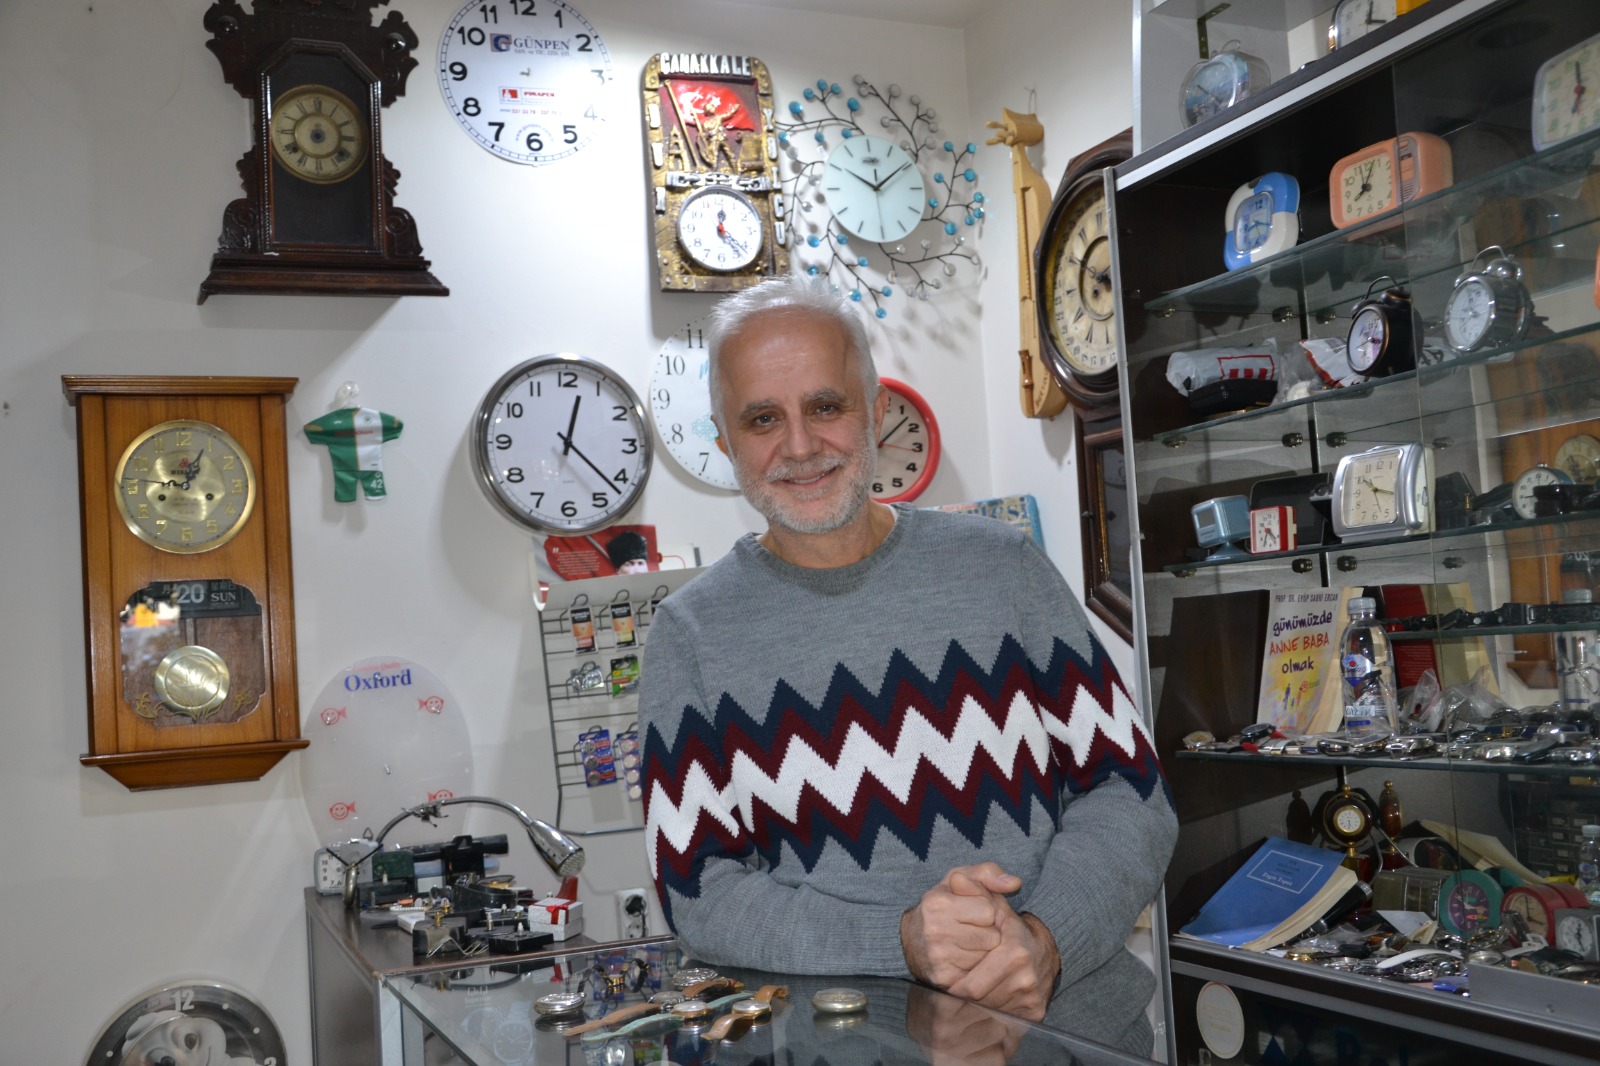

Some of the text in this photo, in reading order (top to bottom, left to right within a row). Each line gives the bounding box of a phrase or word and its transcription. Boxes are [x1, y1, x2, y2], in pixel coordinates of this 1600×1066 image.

[480, 4, 498, 24] 11
[510, 0, 537, 16] 12
[554, 9, 563, 28] 1
[457, 26, 486, 46] 10
[513, 36, 569, 50] GÜNPEN
[575, 33, 593, 52] 2
[449, 61, 467, 81] 9
[591, 69, 605, 85] 3
[462, 97, 482, 117] 8
[583, 104, 598, 121] 4
[488, 122, 505, 142] 7
[563, 125, 578, 144] 5
[526, 132, 543, 152] 6
[702, 200, 710, 209] 11
[715, 198, 724, 206] 12
[732, 202, 736, 210] 1
[691, 211, 703, 219] 10
[741, 213, 748, 221] 2
[687, 224, 696, 233] 9
[747, 227, 753, 236] 3
[694, 238, 702, 247] 8
[703, 248, 711, 258] 7
[717, 253, 726, 262] 6
[687, 329, 704, 348] 11
[665, 355, 685, 376] 10
[558, 372, 578, 388] 12
[529, 381, 541, 397] 11
[596, 381, 600, 397] 1
[658, 388, 670, 410] 9
[507, 402, 523, 418] 10
[612, 406, 628, 421] 2
[899, 405, 905, 415] 1
[671, 423, 684, 444] 8
[908, 423, 920, 433] 2
[176, 431, 192, 446] 12
[207, 438, 212, 451] 1
[495, 434, 512, 450] 9
[621, 438, 638, 454] 3
[912, 442, 924, 453] 3
[223, 455, 234, 470] 2
[699, 452, 709, 472] 7
[906, 462, 918, 472] 4
[1365, 464, 1371, 473] 11
[1376, 460, 1384, 470] 12
[1389, 461, 1393, 469] 1
[506, 467, 524, 483] 8
[614, 468, 629, 484] 4
[892, 478, 903, 488] 5
[127, 479, 138, 495] 9
[232, 478, 243, 493] 3
[370, 479, 383, 489] 42
[872, 482, 884, 493] 6
[530, 492, 545, 508] 7
[592, 492, 608, 508] 5
[1355, 489, 1361, 498] 9
[560, 501, 578, 517] 6
[1356, 501, 1361, 509] 8
[1384, 508, 1389, 518] 5
[1361, 511, 1367, 520] 7
[1372, 512, 1378, 520] 6
[156, 519, 168, 535] 7
[181, 527, 193, 541] 6
[206, 519, 218, 533] 5
[176, 583, 205, 604] 20
[211, 592, 236, 602] SUN
[1273, 610, 1333, 637] günümüzde
[1269, 632, 1330, 656] ANNE BABA
[1281, 656, 1314, 674] olmak
[344, 668, 412, 692] Oxford
[171, 989, 195, 1012] 12
